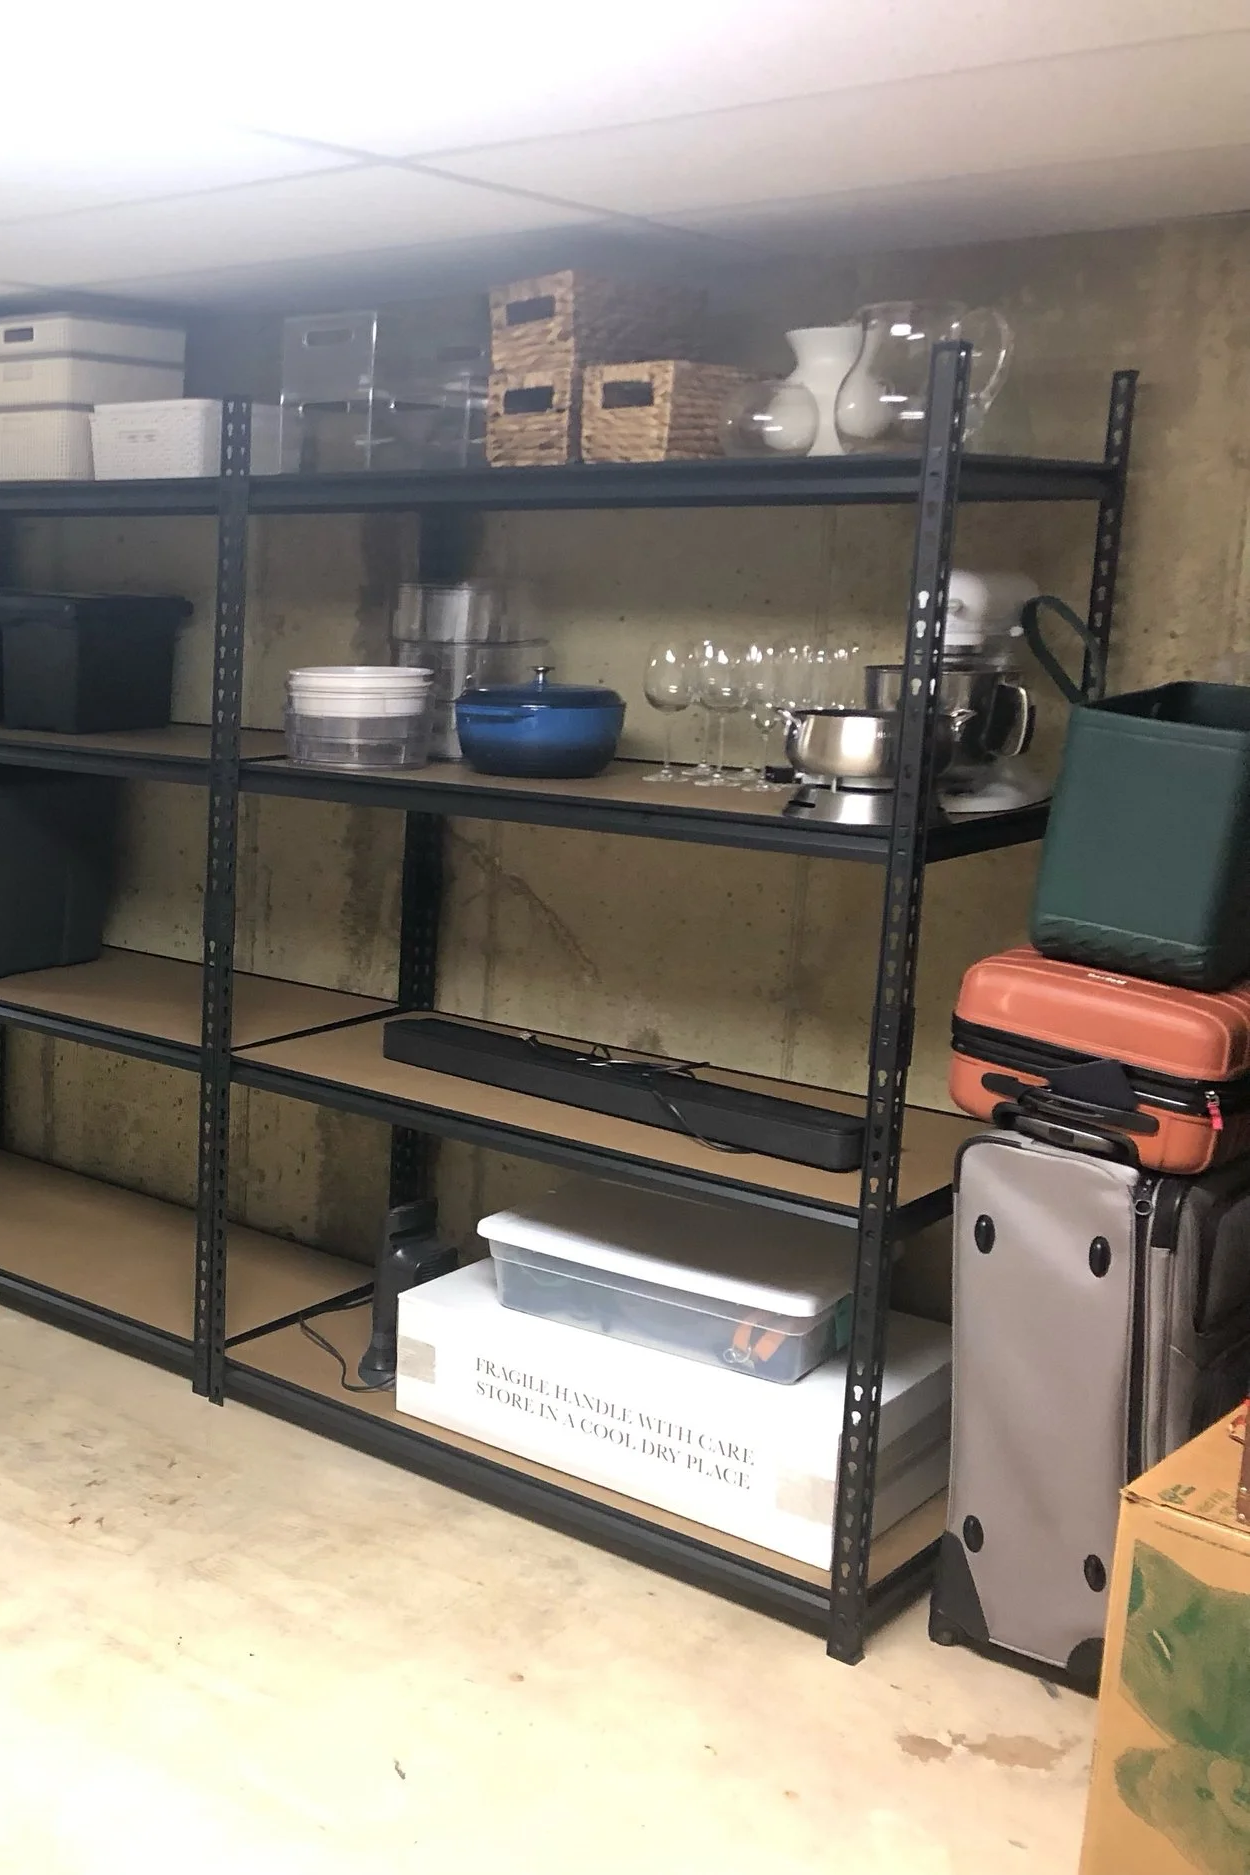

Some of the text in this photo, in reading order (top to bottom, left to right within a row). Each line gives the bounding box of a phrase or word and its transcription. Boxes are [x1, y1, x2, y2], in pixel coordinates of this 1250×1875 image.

[476, 1356, 755, 1466] FRAGILE HANDLE WITH CARE
[476, 1381, 752, 1490] STORE IN A COOL DRY PLACE
